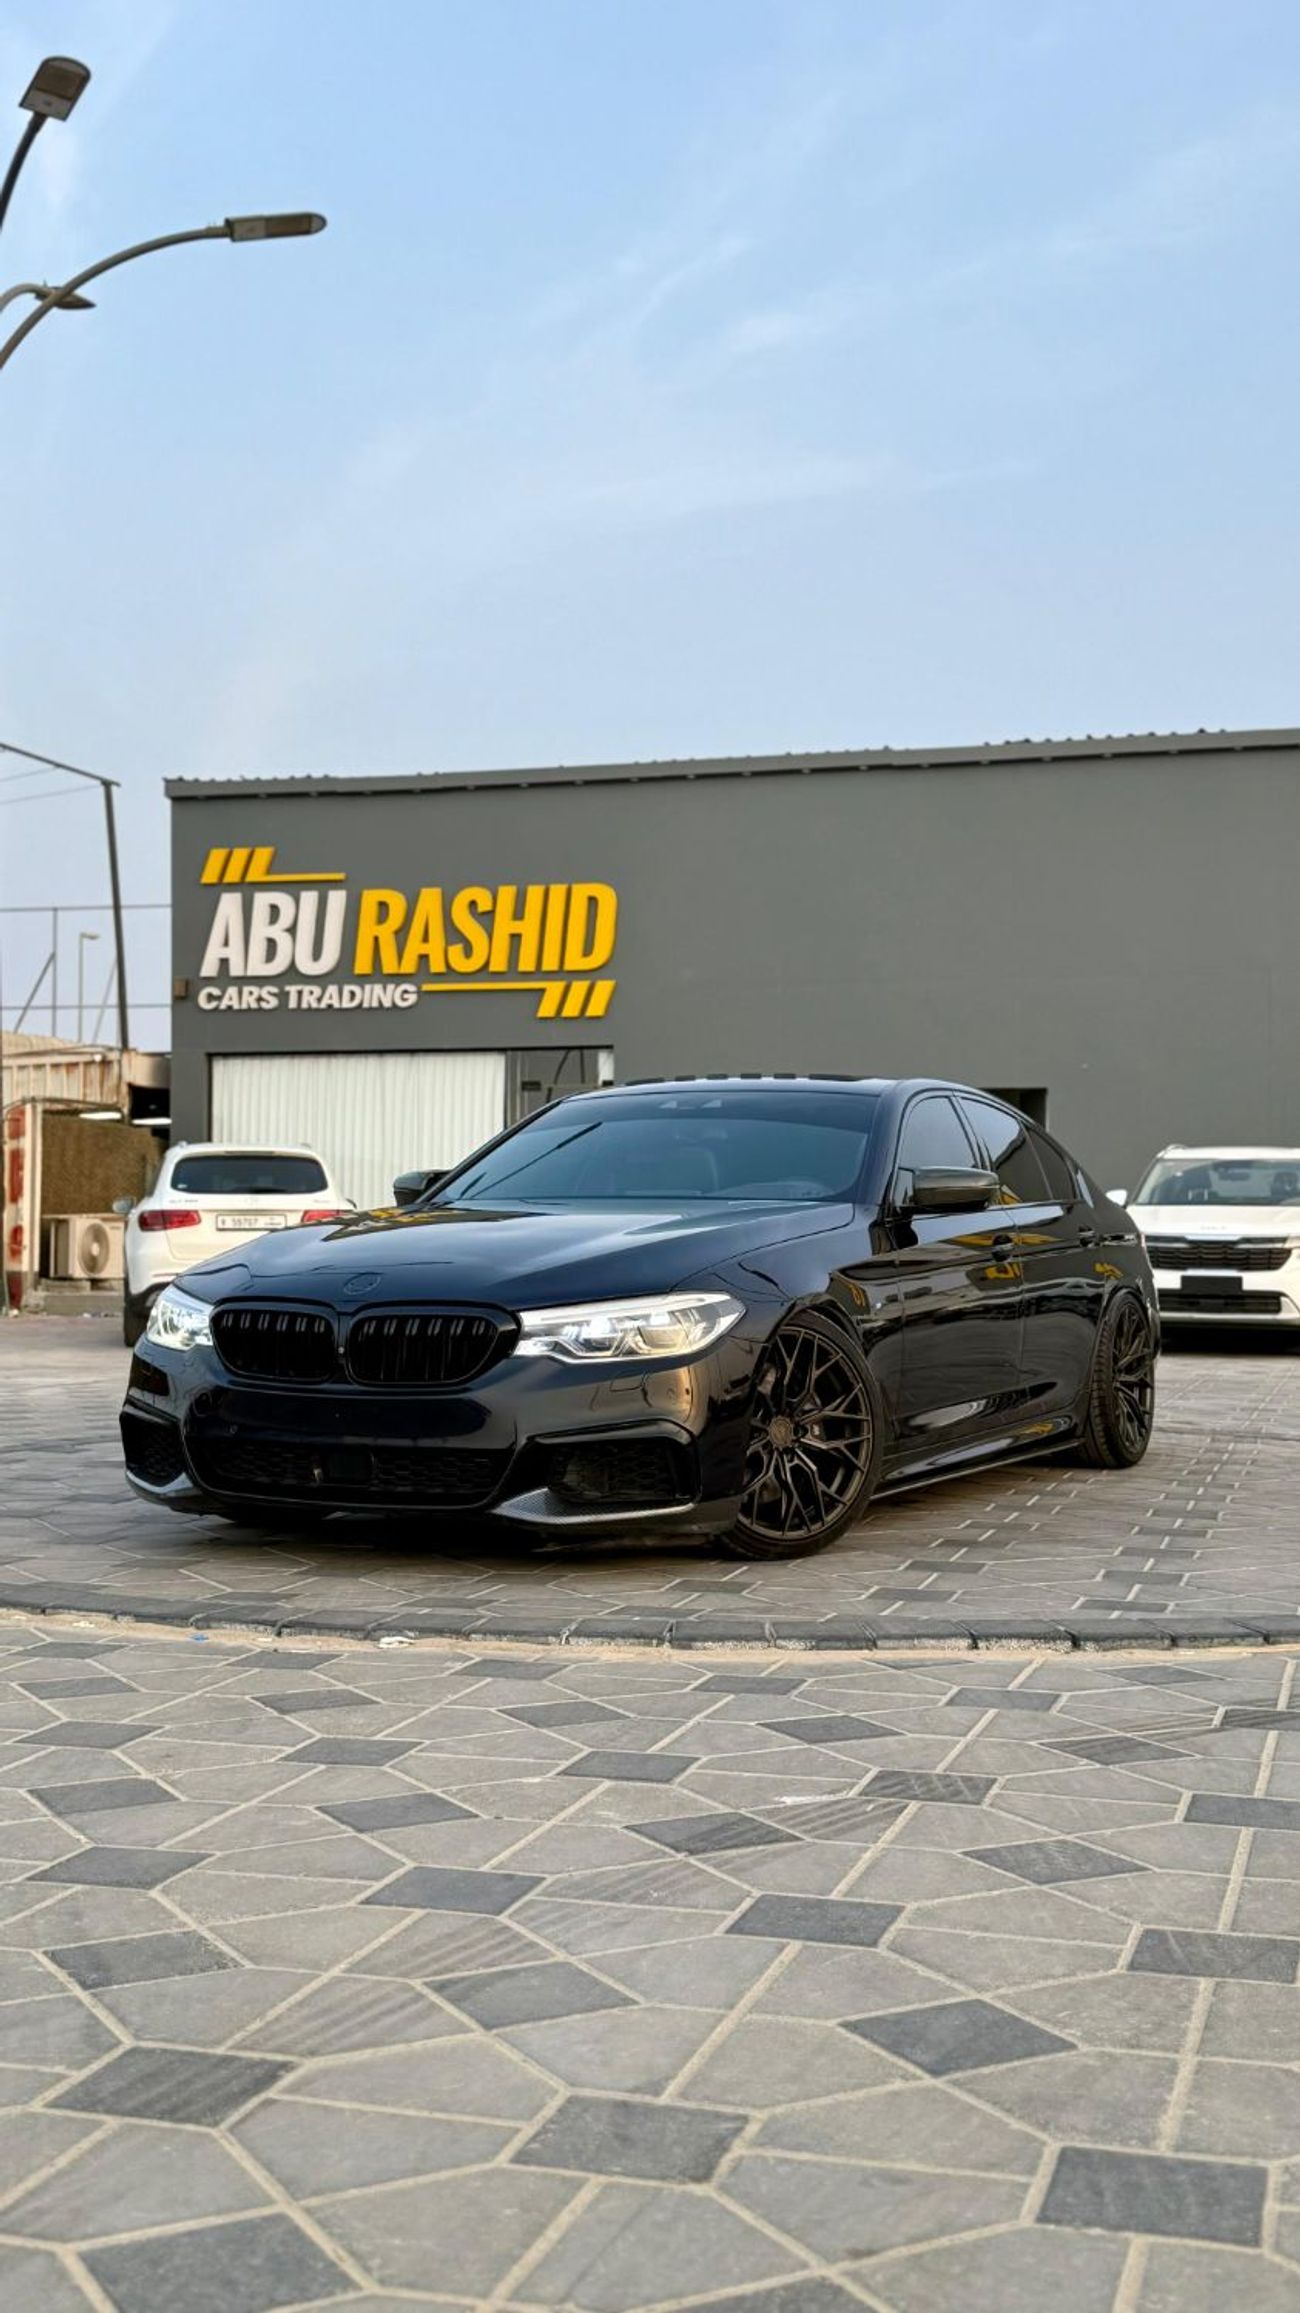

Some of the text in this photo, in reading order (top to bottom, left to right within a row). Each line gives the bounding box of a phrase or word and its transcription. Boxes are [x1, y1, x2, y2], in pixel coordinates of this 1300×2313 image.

[199, 882, 619, 979] ABU RASHID
[197, 983, 418, 1012] CARS TRADING
